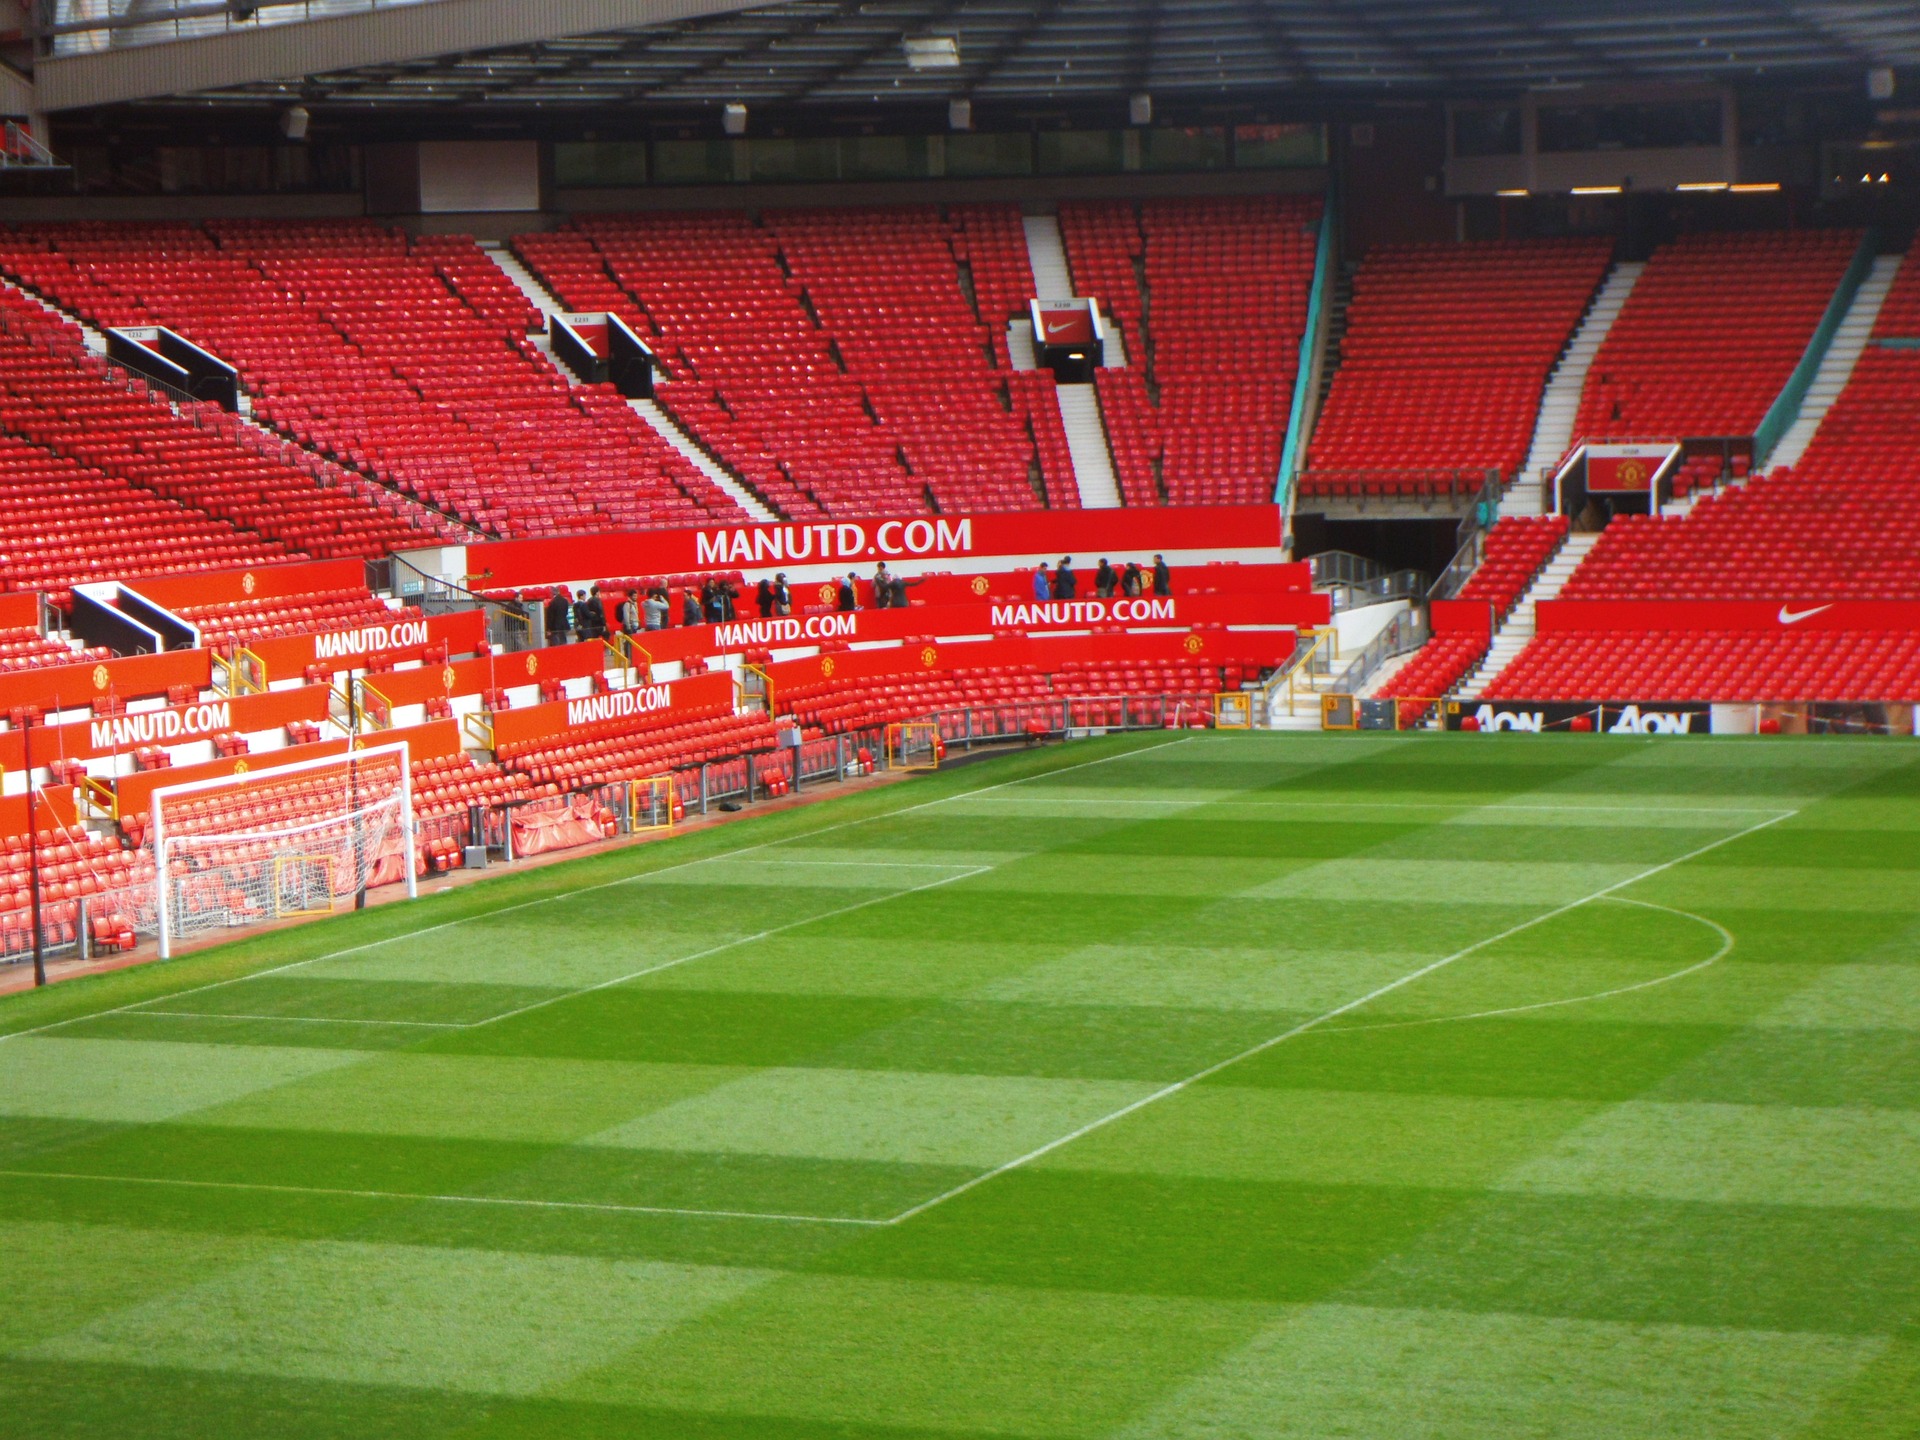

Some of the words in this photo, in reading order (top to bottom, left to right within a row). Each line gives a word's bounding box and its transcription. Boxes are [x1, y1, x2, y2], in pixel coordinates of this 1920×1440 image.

[697, 518, 972, 564] MANUTD.COM
[715, 613, 856, 647] MANUTD.COM
[990, 598, 1176, 626] MANUTD.COM
[315, 620, 428, 659] MANUTD.COM
[90, 701, 230, 749] MANUTD.COM
[567, 684, 671, 726] MANUTD.COM
